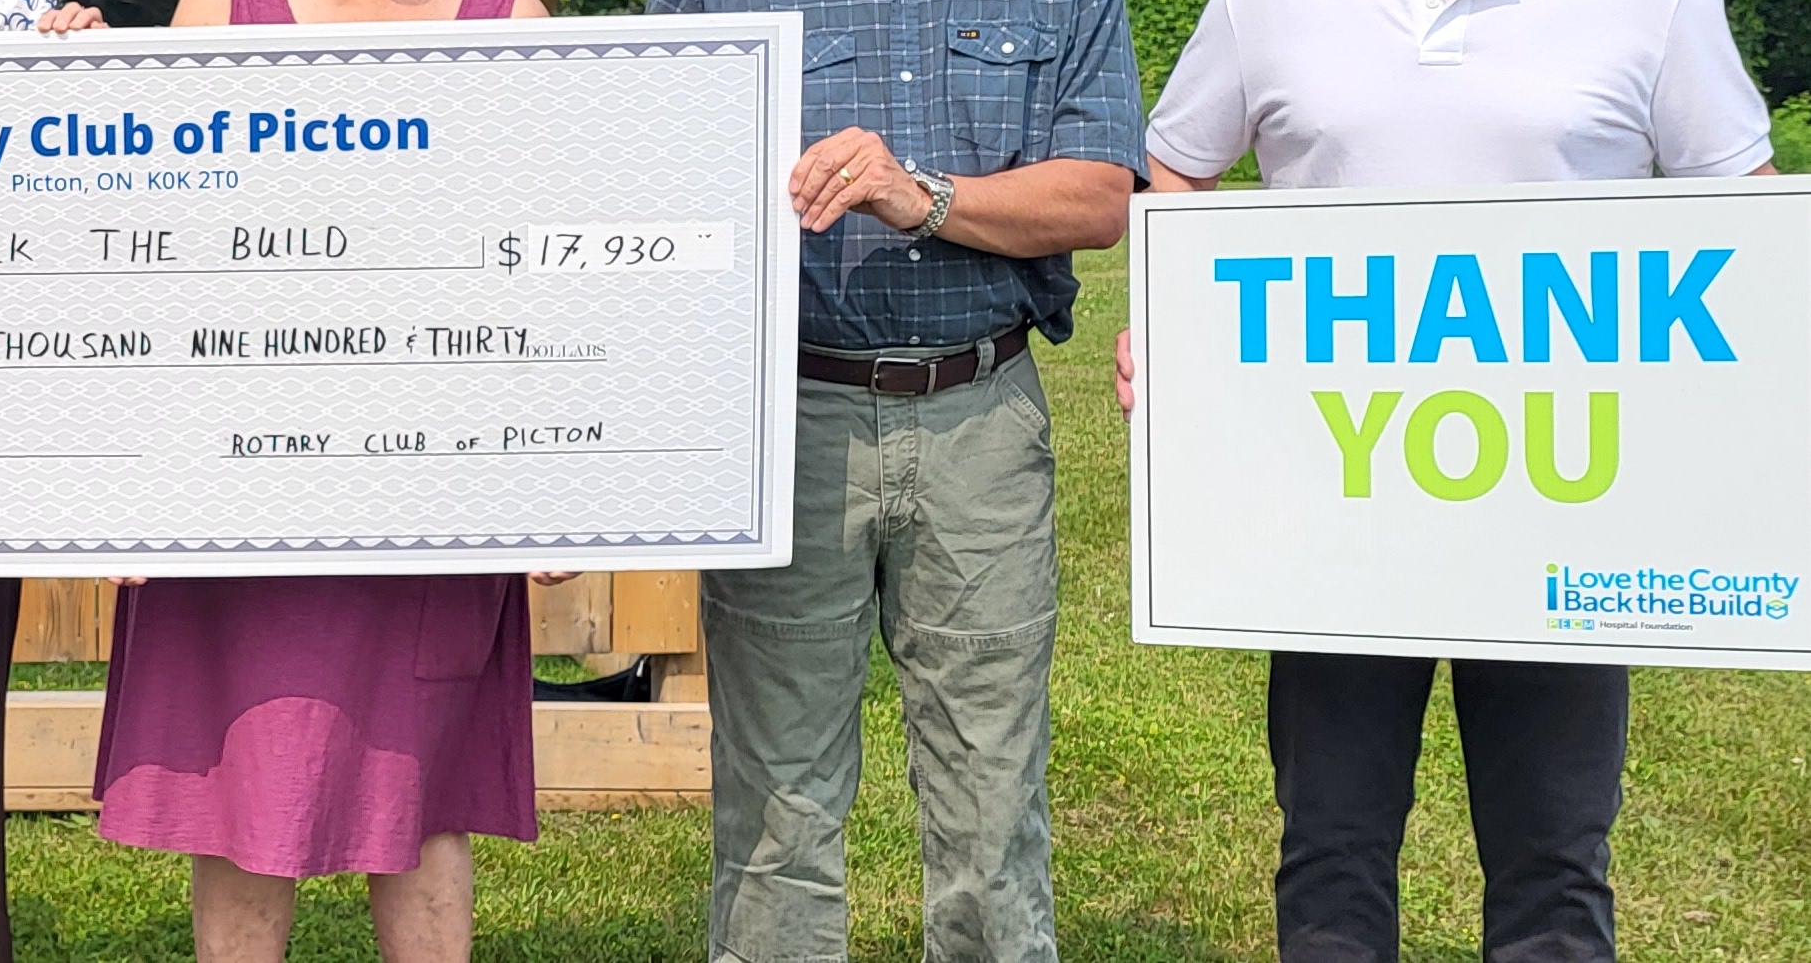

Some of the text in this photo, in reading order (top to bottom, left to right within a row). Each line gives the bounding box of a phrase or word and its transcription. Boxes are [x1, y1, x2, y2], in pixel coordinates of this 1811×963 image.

[30, 113, 154, 157] Club
[174, 111, 230, 154] of
[249, 109, 430, 153] Picton
[12, 172, 90, 195] Picton,
[98, 171, 133, 192] ON
[148, 170, 193, 191] K0K
[90, 229, 178, 264] THE
[232, 226, 348, 261] BUILD
[1214, 248, 1738, 364] THANK
[191, 327, 251, 358] NINE
[264, 326, 387, 357] HUNDRED
[425, 325, 527, 356] THIRTY
[526, 344, 607, 358] DOLLARS
[231, 434, 331, 457] ROTARY
[364, 432, 426, 454] CLUB
[503, 422, 603, 451] PICTON
[1310, 389, 1620, 504] YOU
[1564, 566, 1631, 589] Love
[1637, 568, 1684, 590] the
[1689, 568, 1799, 599] County
[1565, 590, 1761, 616] Back the Build
[1600, 620, 1638, 630] Hospital
[1640, 622, 1693, 631] Foundation
